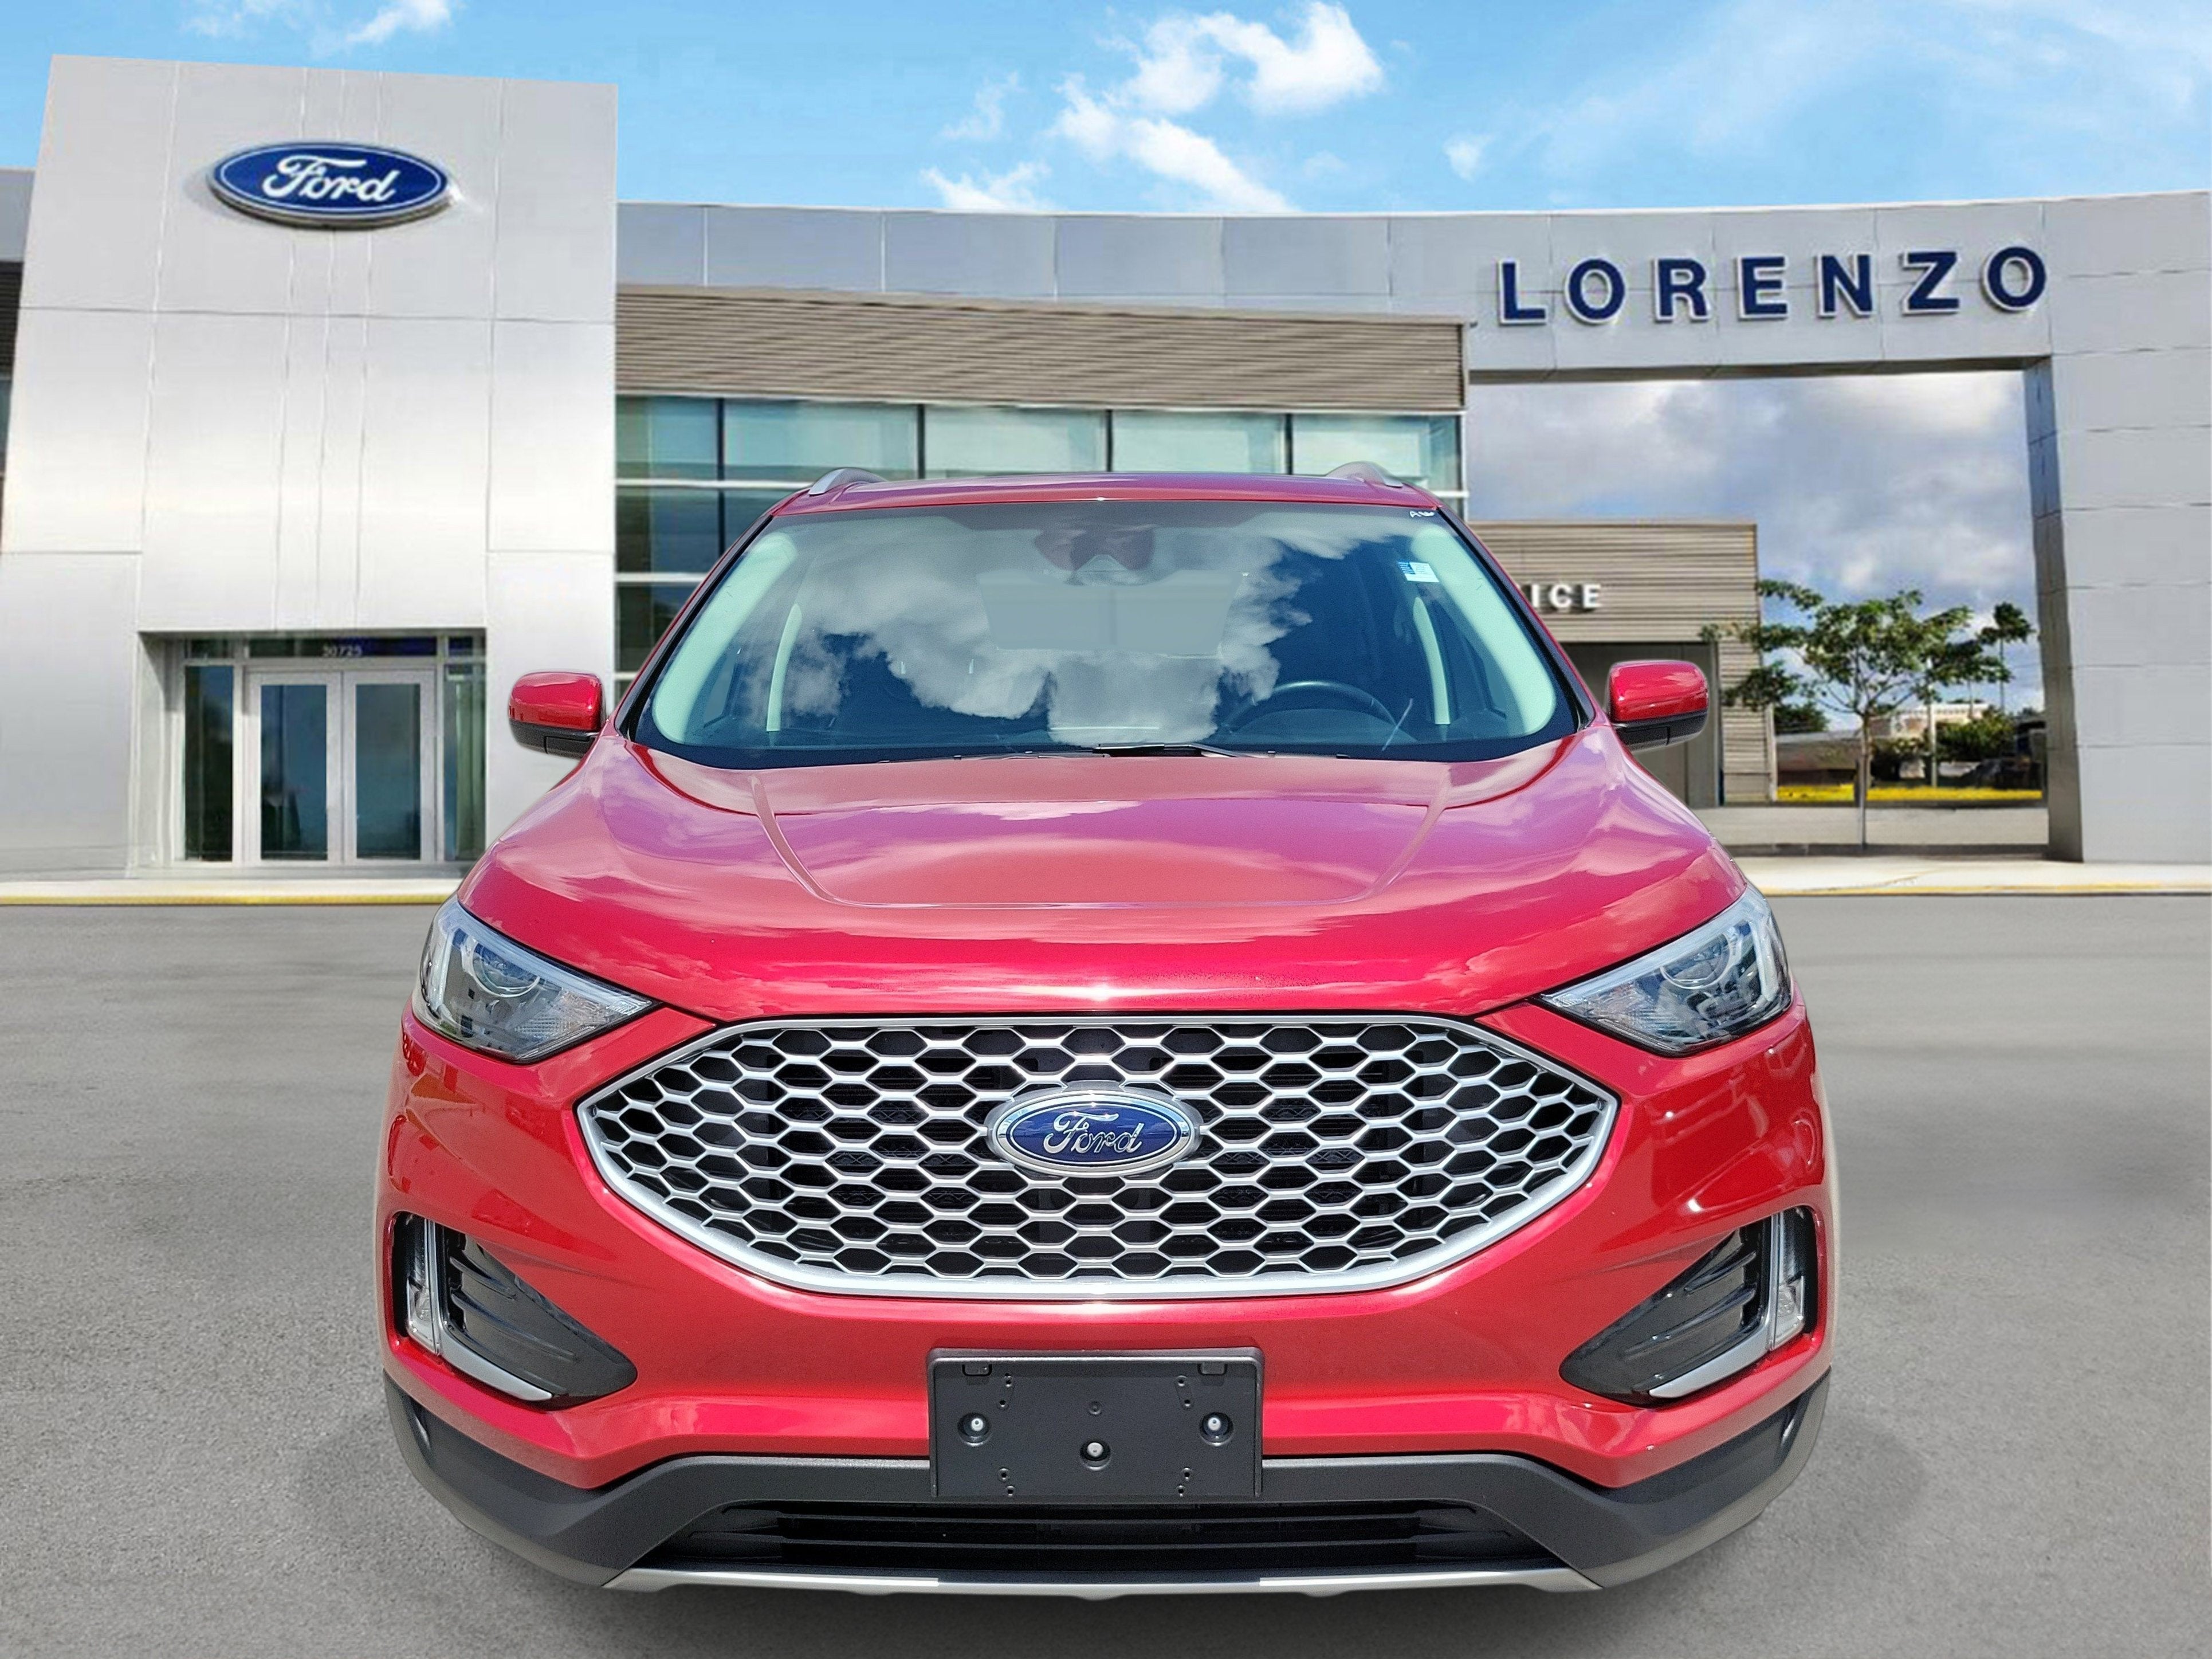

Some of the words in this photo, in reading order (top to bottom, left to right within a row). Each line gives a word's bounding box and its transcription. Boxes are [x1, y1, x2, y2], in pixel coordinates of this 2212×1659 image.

[262, 154, 400, 202] Ford
[1497, 245, 2048, 324] LORENZO
[1531, 583, 1602, 609] ICE
[1043, 1111, 1145, 1154] Ford
